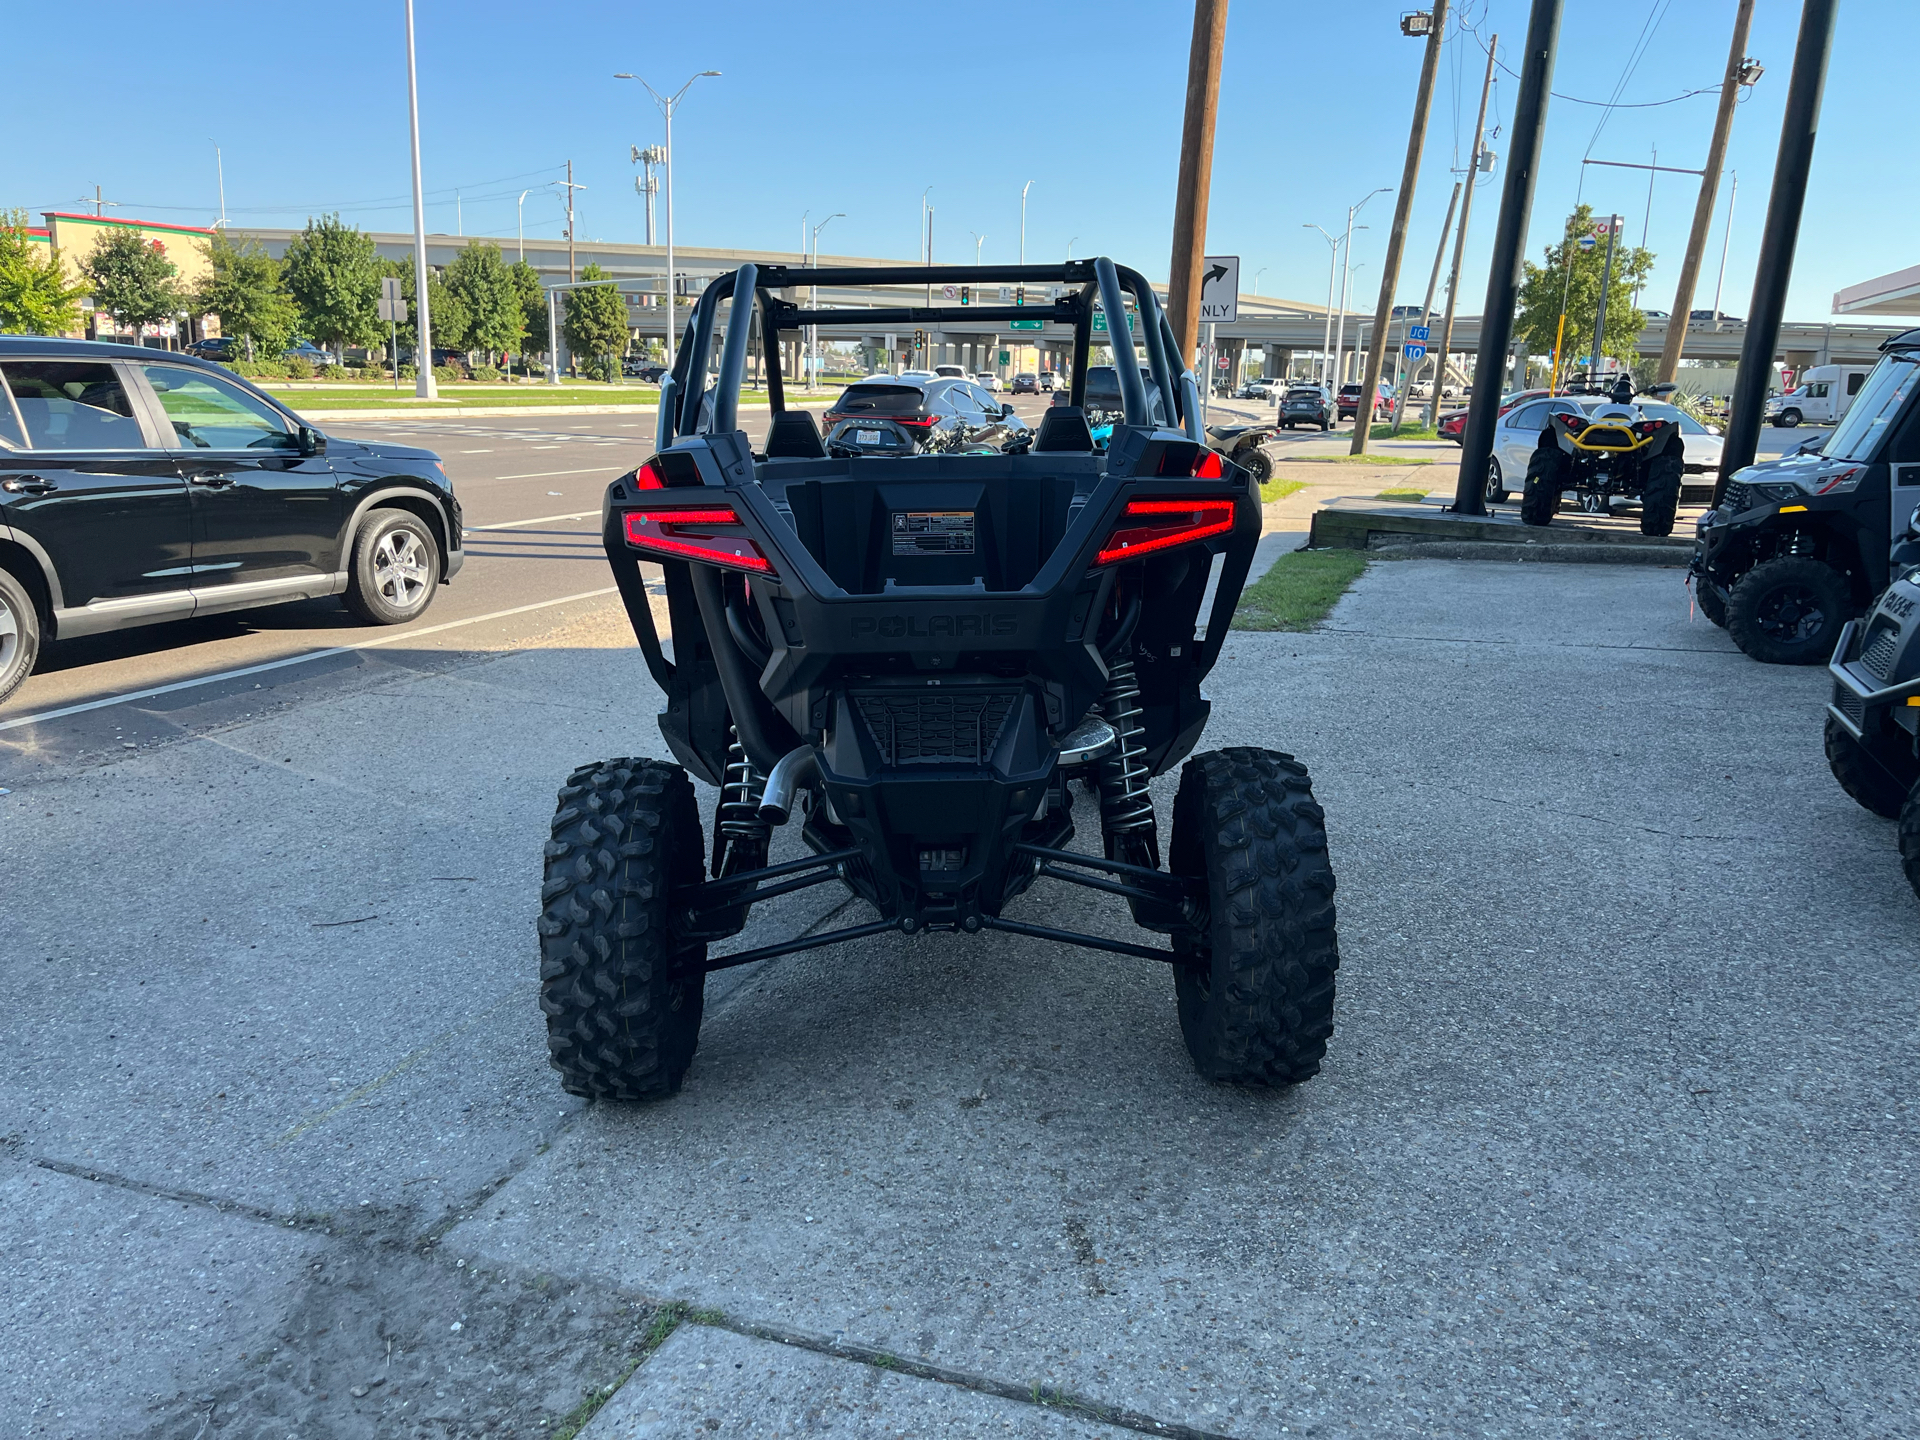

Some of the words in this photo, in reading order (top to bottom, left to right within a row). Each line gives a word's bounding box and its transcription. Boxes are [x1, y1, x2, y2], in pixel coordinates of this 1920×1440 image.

[1202, 304, 1230, 317] NLY
[1411, 328, 1429, 339] JCT
[1408, 347, 1423, 360] 10
[1815, 474, 1853, 484] 570
[850, 613, 1019, 639] POLARIS
[0, 662, 29, 698] Hankoo
